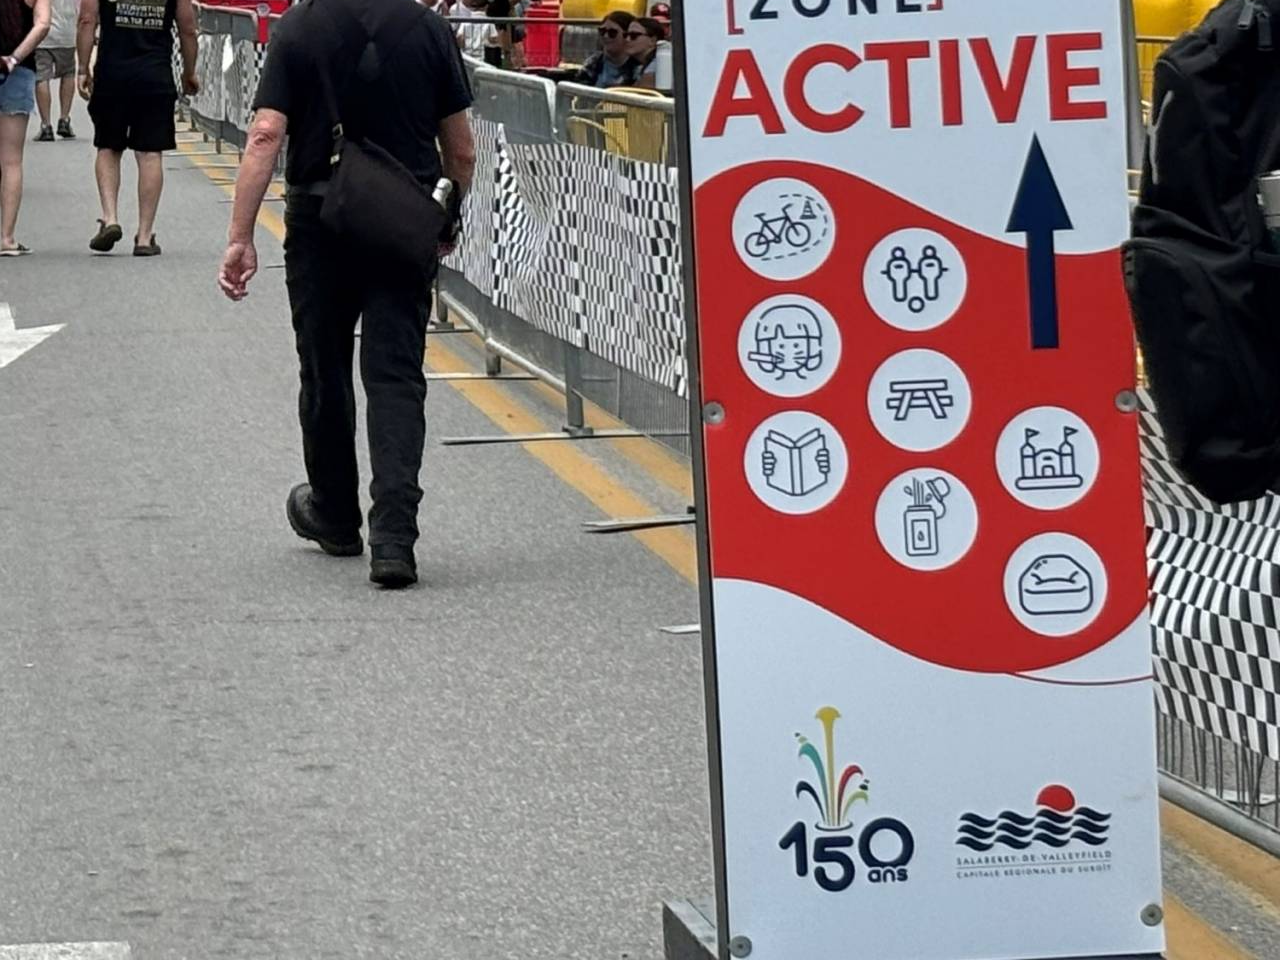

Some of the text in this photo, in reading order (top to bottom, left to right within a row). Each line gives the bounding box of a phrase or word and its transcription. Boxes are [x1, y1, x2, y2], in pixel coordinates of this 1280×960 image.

[701, 32, 1108, 138] ACTIVE
[778, 817, 915, 892] 150
[867, 865, 908, 883] ans
[956, 870, 999, 879] CAPITALE
[1060, 866, 1073, 874] DU
